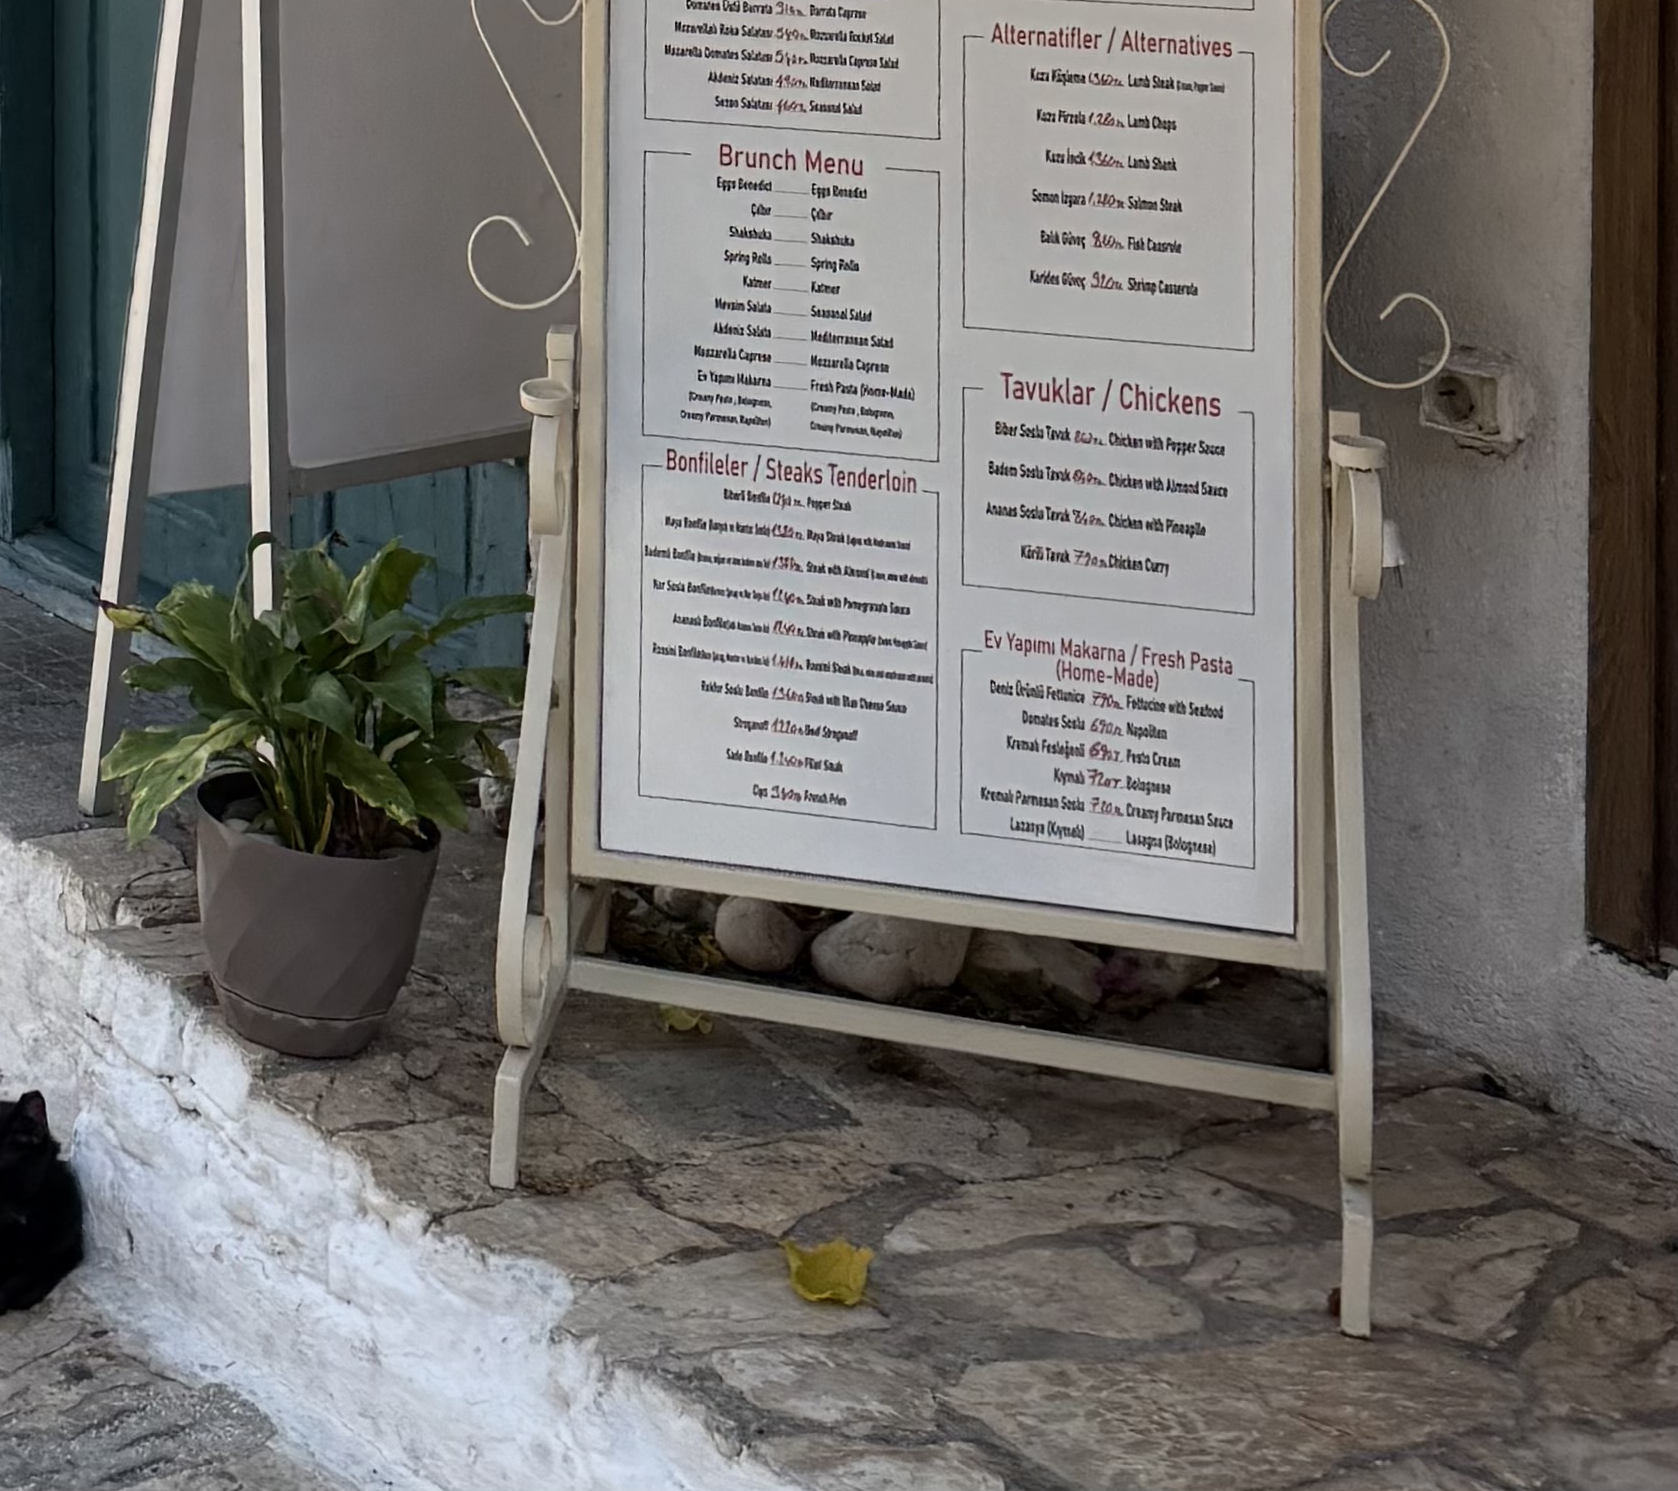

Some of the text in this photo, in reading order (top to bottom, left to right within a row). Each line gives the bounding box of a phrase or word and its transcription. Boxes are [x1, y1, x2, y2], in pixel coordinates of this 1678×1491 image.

[991, 23, 1232, 57] Alternatifler / Alternatives
[720, 144, 863, 176] Brunch Menu
[1000, 372, 1220, 417] Tavuklar / Chickens
[666, 448, 916, 493] Bonfileler / Steaks Tenderloin
[985, 630, 1232, 675] Ev Yapımı Makarna / Fresh Pasta
[1056, 655, 1161, 692] (Home-Made)
